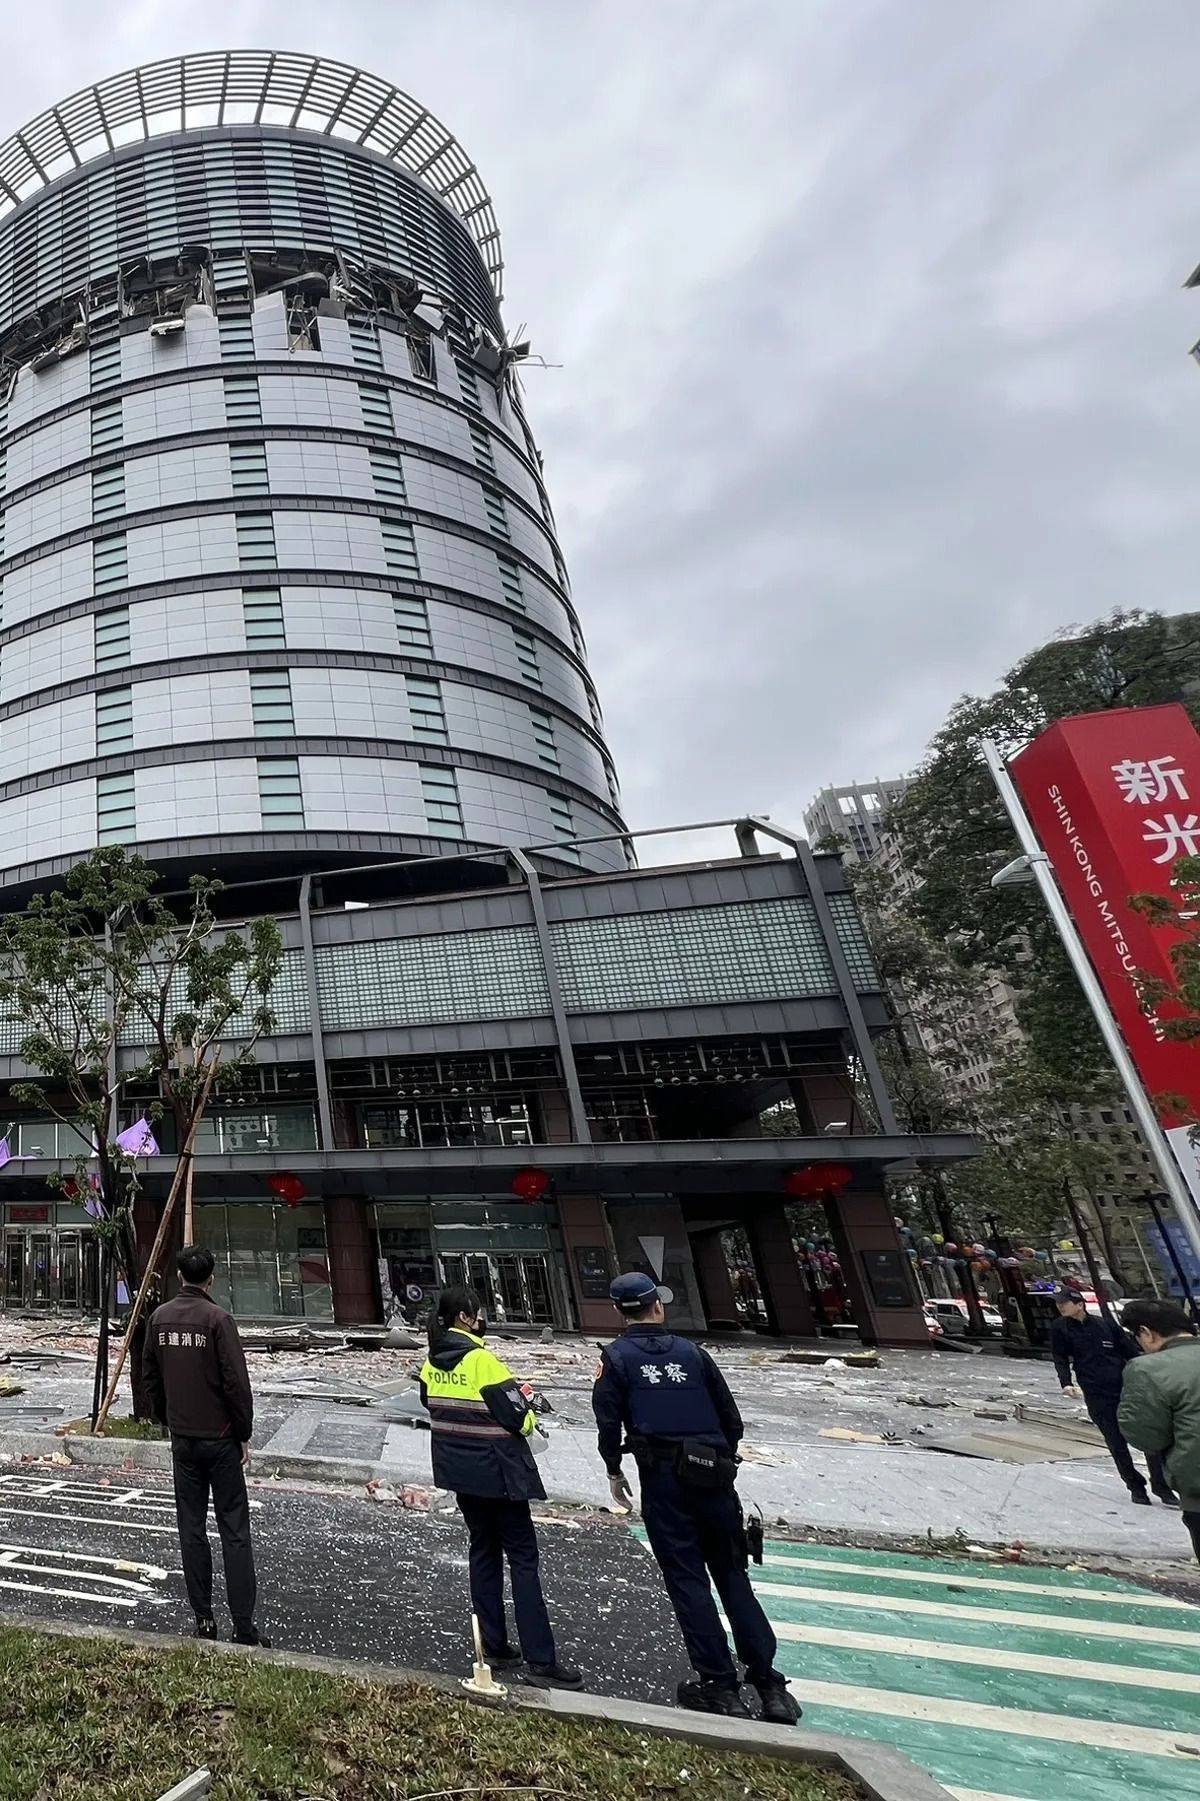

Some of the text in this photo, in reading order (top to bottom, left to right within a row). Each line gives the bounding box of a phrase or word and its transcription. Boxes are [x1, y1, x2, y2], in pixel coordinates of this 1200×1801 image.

[1048, 784, 1076, 835] SHIN
[1070, 836, 1103, 897] KONG
[428, 1371, 468, 1386] POLICE
[640, 1362, 689, 1385] 警察
